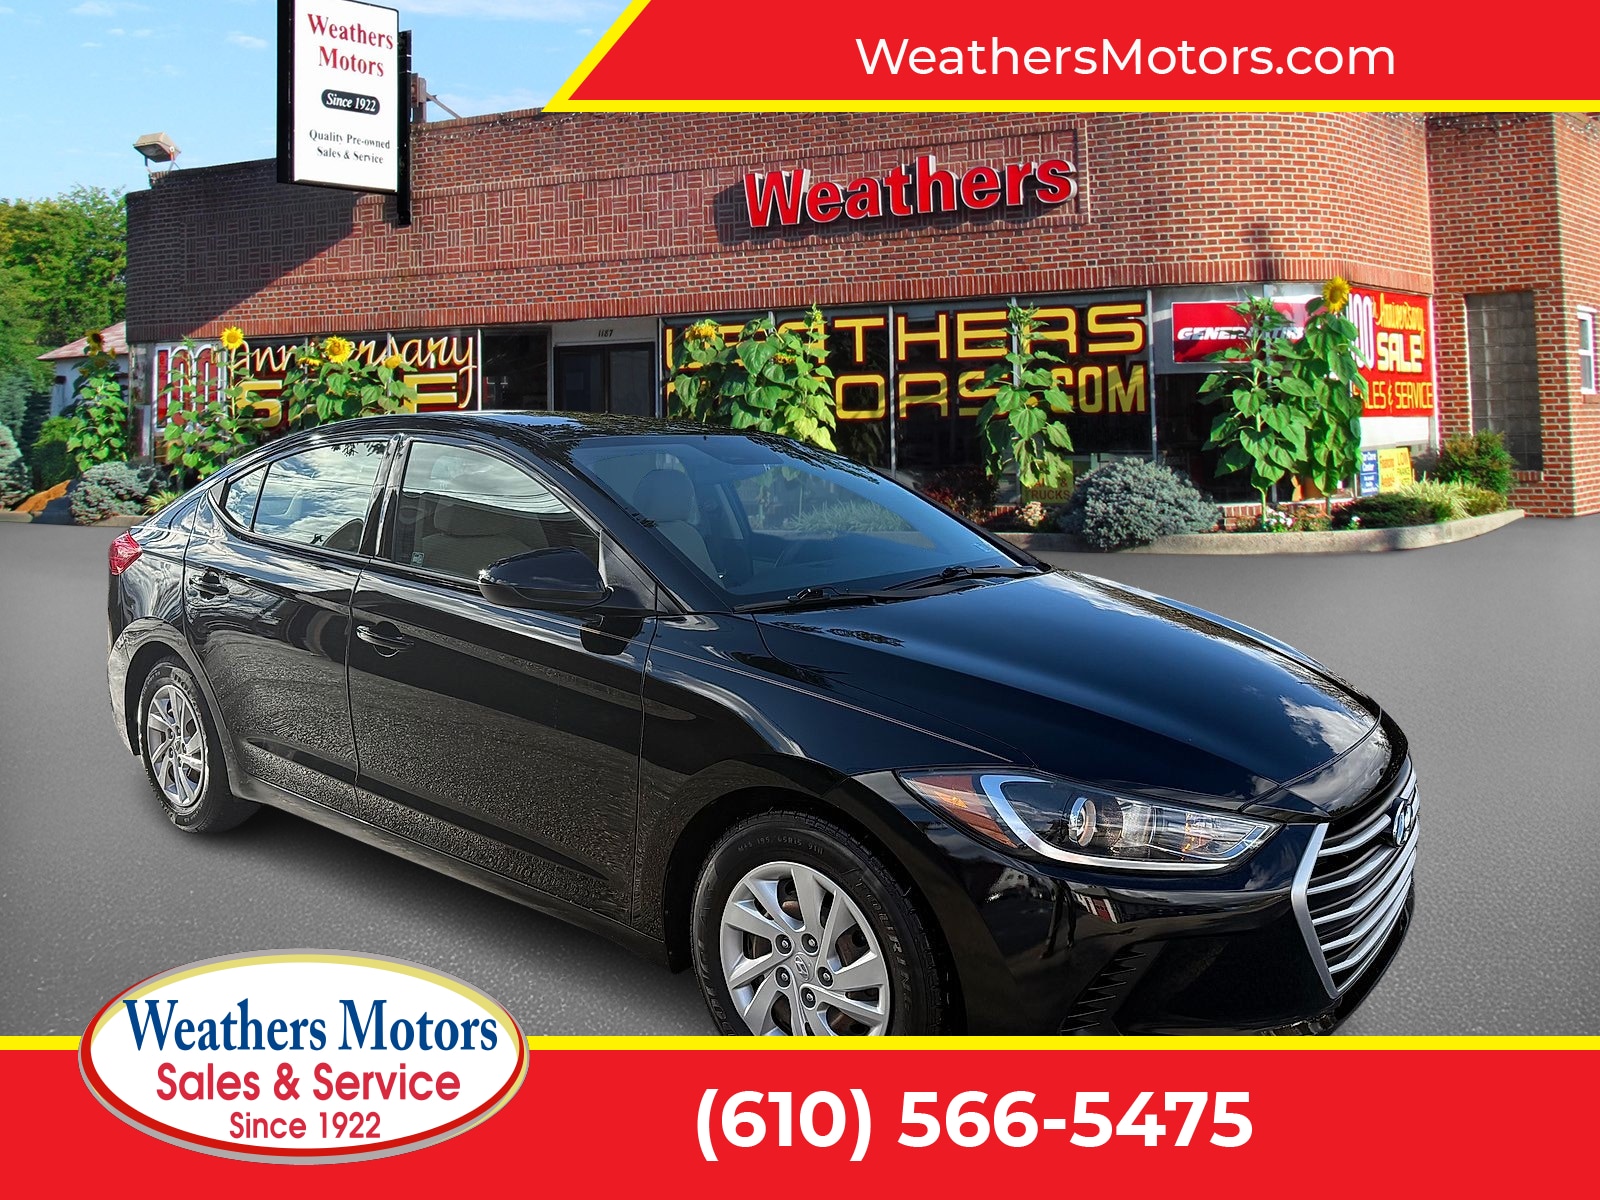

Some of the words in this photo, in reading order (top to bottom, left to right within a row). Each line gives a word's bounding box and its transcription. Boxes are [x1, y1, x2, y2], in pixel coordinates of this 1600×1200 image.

[307, 13, 393, 50] Weathers
[318, 45, 384, 78] Motors
[326, 92, 353, 109] Since
[353, 97, 377, 113] 1922
[309, 129, 343, 145] Quality
[346, 134, 390, 150] Pre-owned
[316, 146, 342, 160] Sales
[343, 151, 351, 161] &
[353, 152, 384, 165] Service
[743, 155, 1078, 228] Weathers
[598, 328, 614, 338] 1187
[1376, 332, 1423, 373] SALE
[1395, 381, 1434, 409] SERVICE
